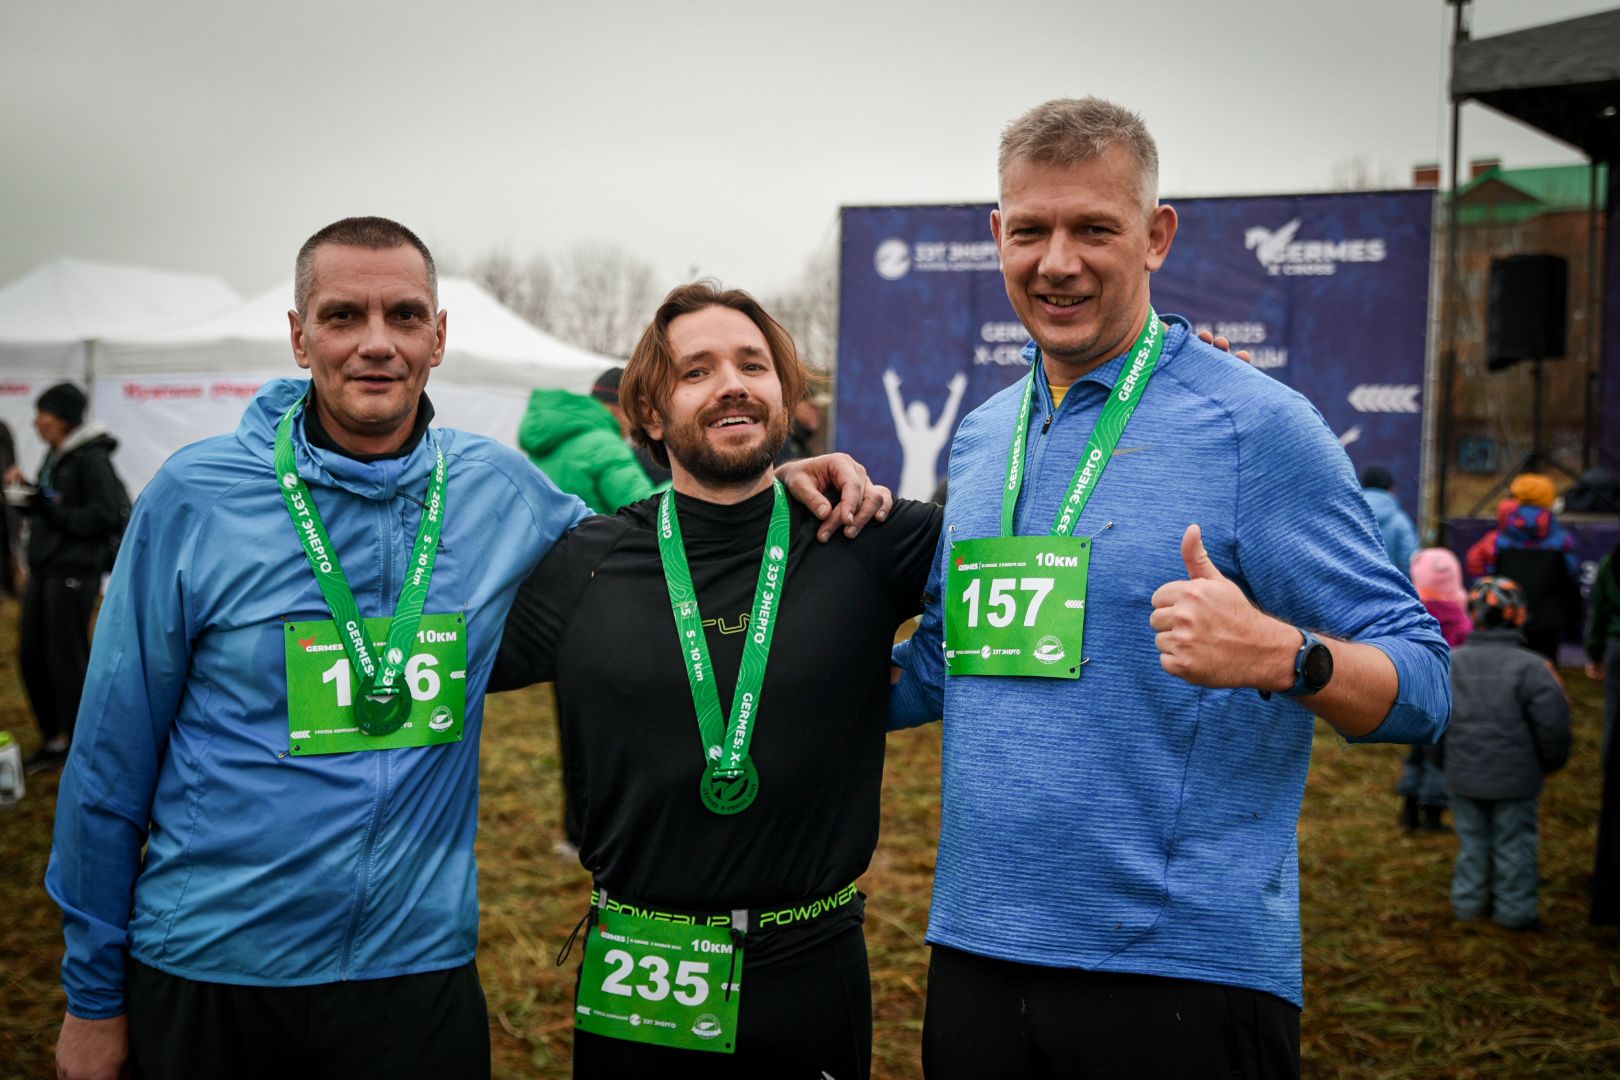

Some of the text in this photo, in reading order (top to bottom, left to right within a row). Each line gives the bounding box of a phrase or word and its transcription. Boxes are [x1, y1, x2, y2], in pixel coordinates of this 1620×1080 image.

[1118, 347, 1150, 401] GERMES:
[1008, 433, 1022, 490] GERMES:
[429, 492, 440, 522] 2025
[1057, 449, 1102, 533] ЗЭТ ЭНЕРГО
[291, 491, 332, 573] ЗЭТ ЭНЕРГО
[418, 553, 428, 565] 10
[413, 569, 424, 585] km
[754, 564, 779, 643] ЗЭТ ЭНЕРГО
[962, 577, 1055, 627] 157
[306, 643, 343, 652] GERMES
[346, 620, 375, 677] GERMES:
[691, 648, 700, 661] 10
[694, 663, 703, 681] km
[322, 653, 440, 707] 16
[733, 693, 753, 749] GERMES:
[601, 949, 709, 1007] 235
